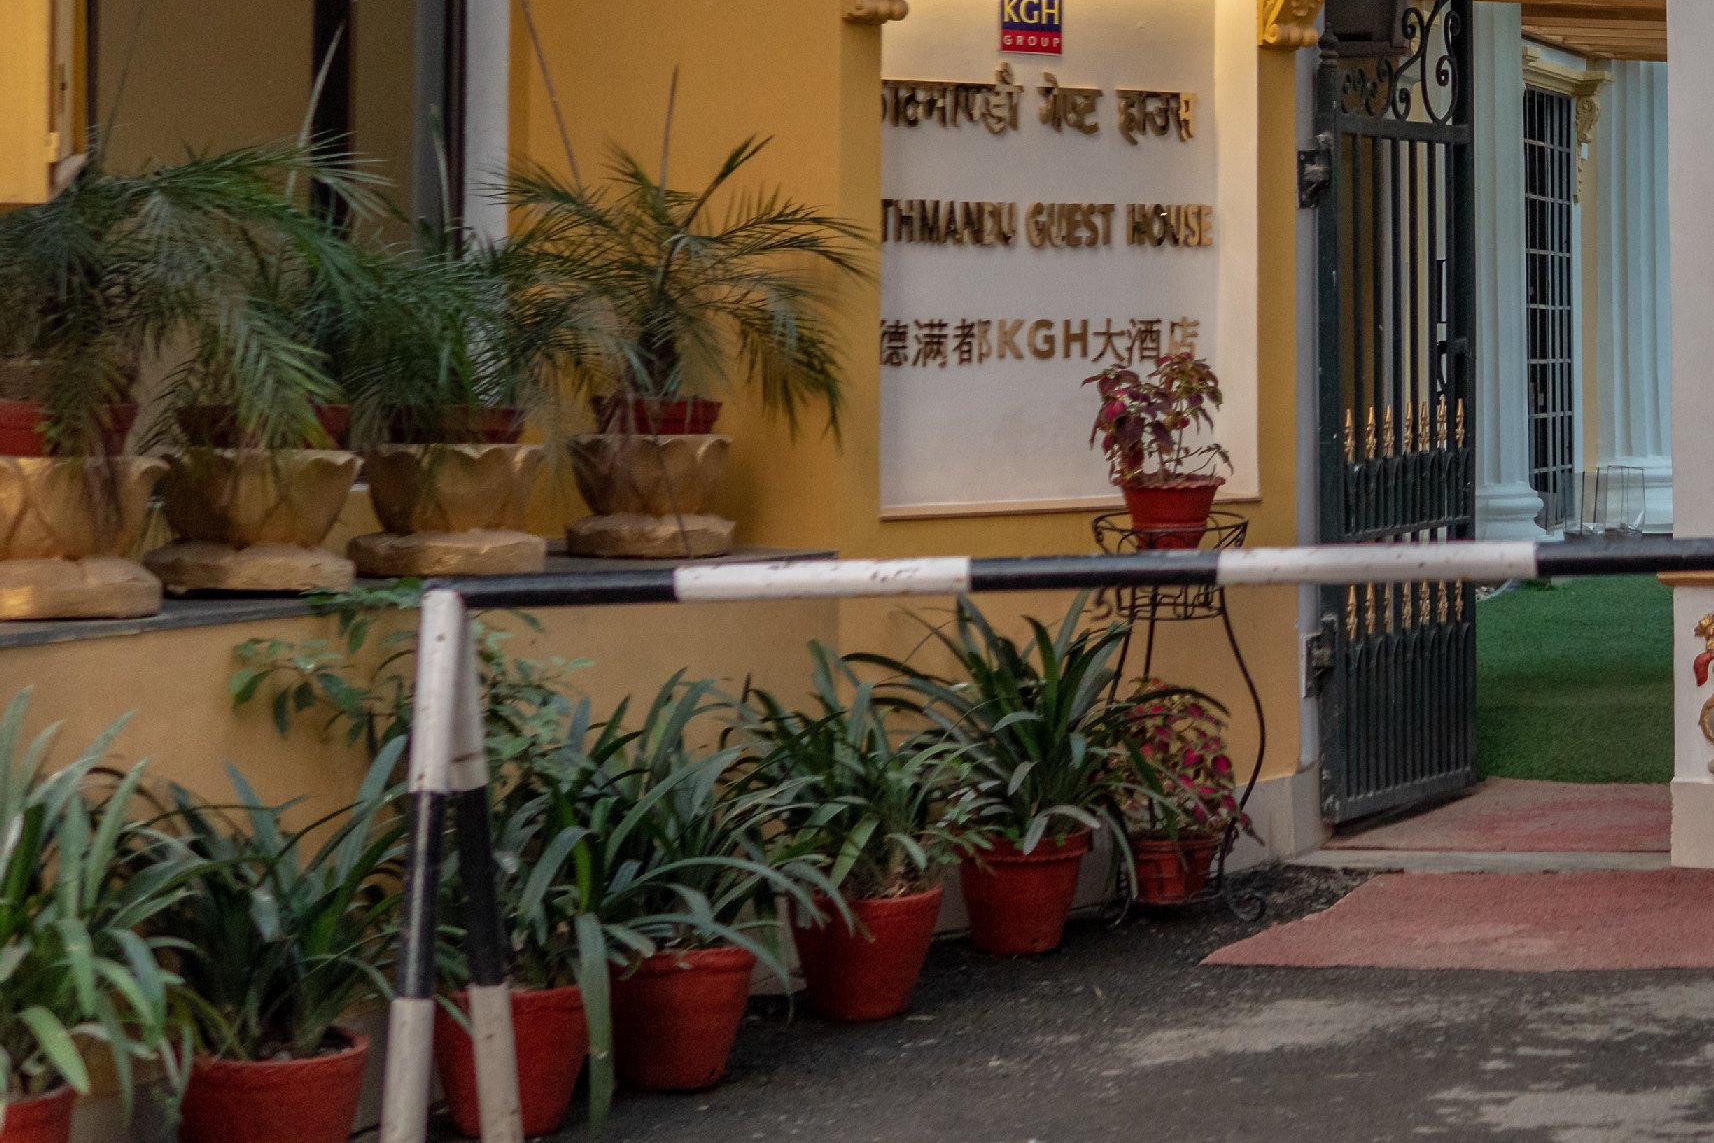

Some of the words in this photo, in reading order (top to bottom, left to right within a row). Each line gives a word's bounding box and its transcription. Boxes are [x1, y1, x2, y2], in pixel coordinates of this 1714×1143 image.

[1003, 35, 1060, 48] GROUP
[1026, 202, 1115, 247] GUEST
[1126, 203, 1213, 246] HOUSE
